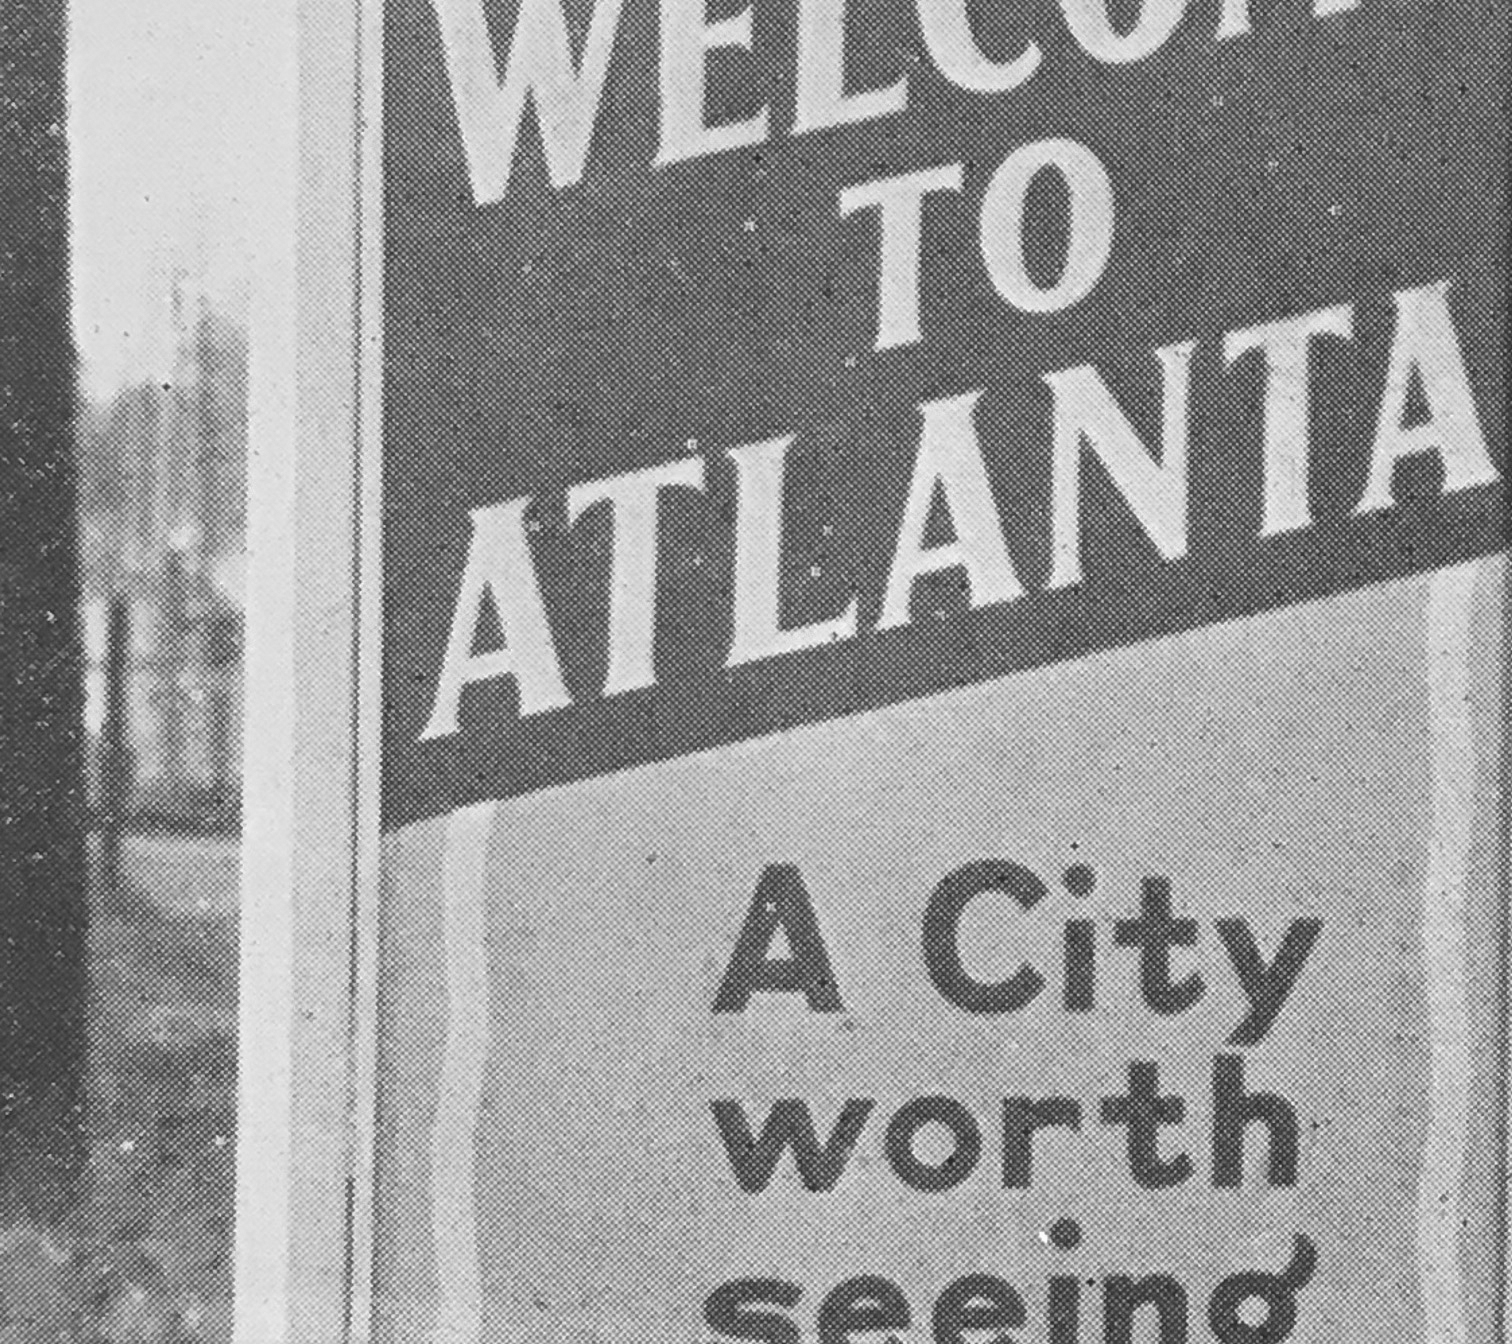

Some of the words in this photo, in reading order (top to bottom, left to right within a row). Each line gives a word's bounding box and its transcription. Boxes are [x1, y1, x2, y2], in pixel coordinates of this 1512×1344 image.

[836, 136, 1117, 354] TO
[417, 278, 1500, 743] ATLANTA
[711, 864, 845, 1014] A
[920, 858, 1325, 1048] City
[709, 1053, 1300, 1193] worth
